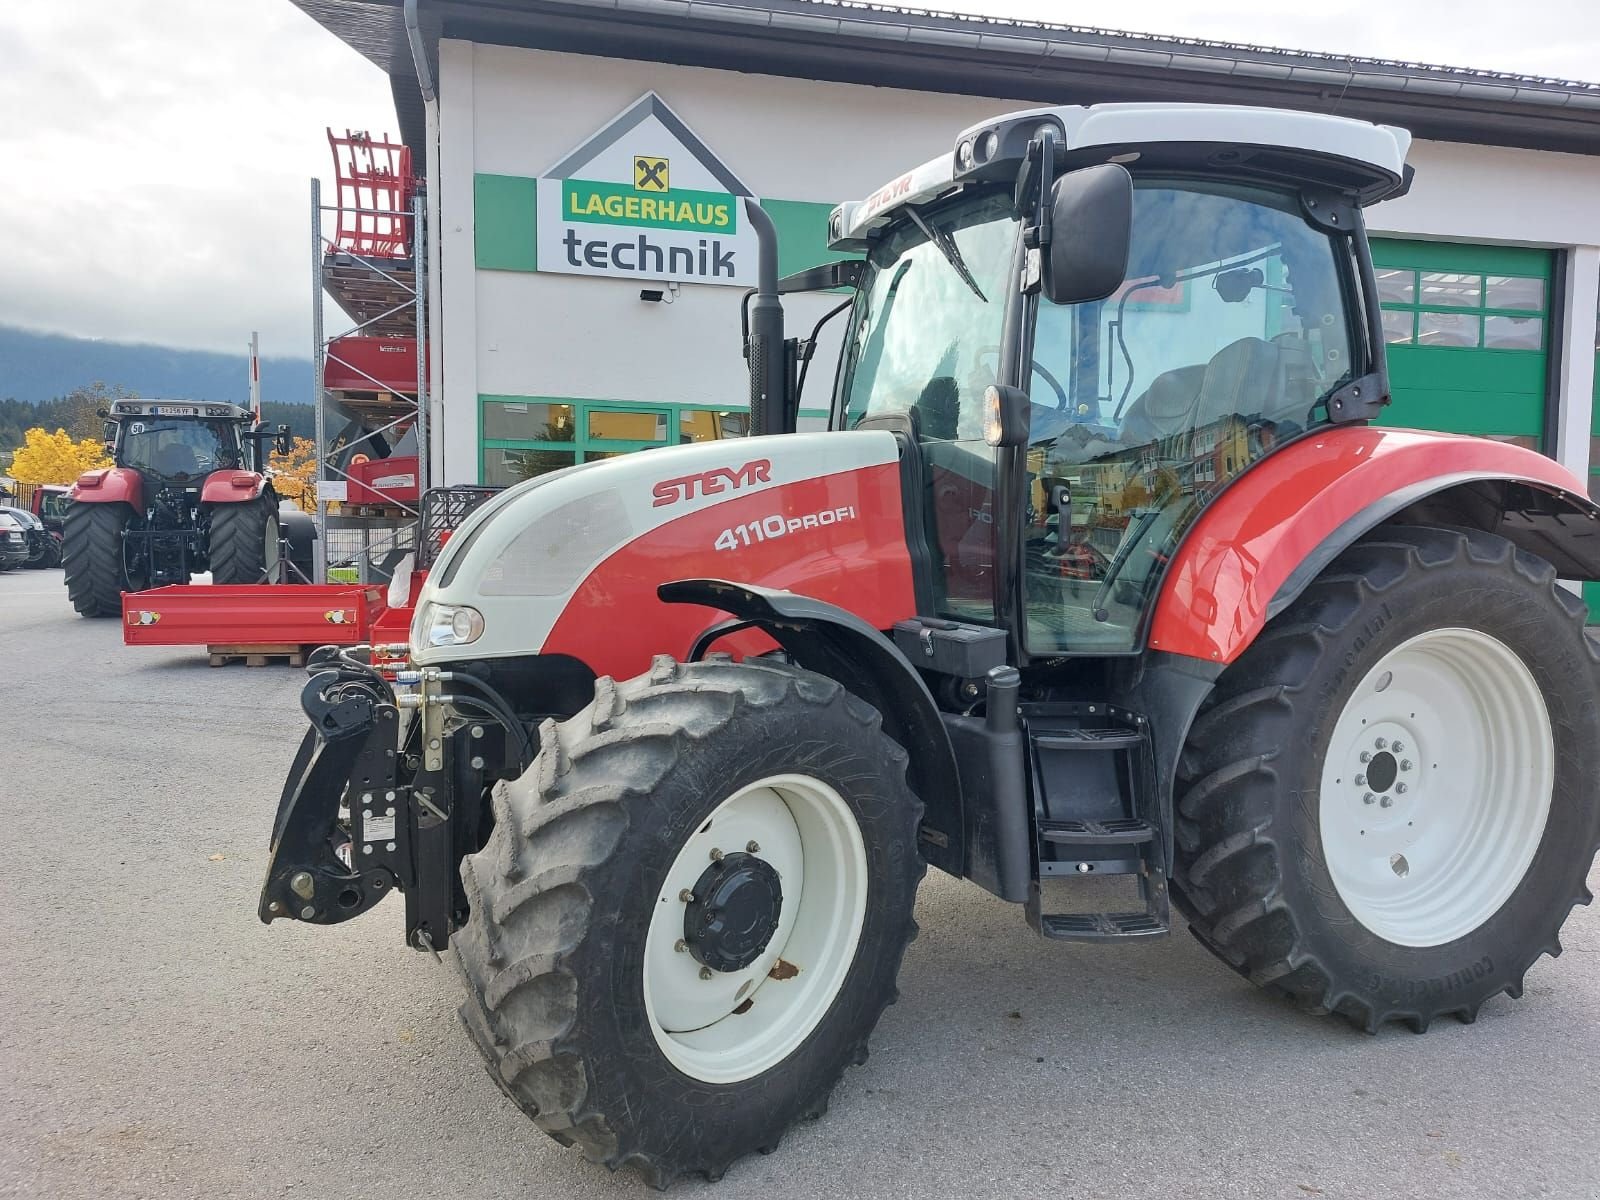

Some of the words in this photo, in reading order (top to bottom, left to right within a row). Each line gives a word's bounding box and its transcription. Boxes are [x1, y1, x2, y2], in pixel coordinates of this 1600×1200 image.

[571, 192, 729, 226] LAGERHAUS
[563, 229, 736, 278] technik
[133, 424, 143, 434] 50
[652, 458, 771, 507] STEYR
